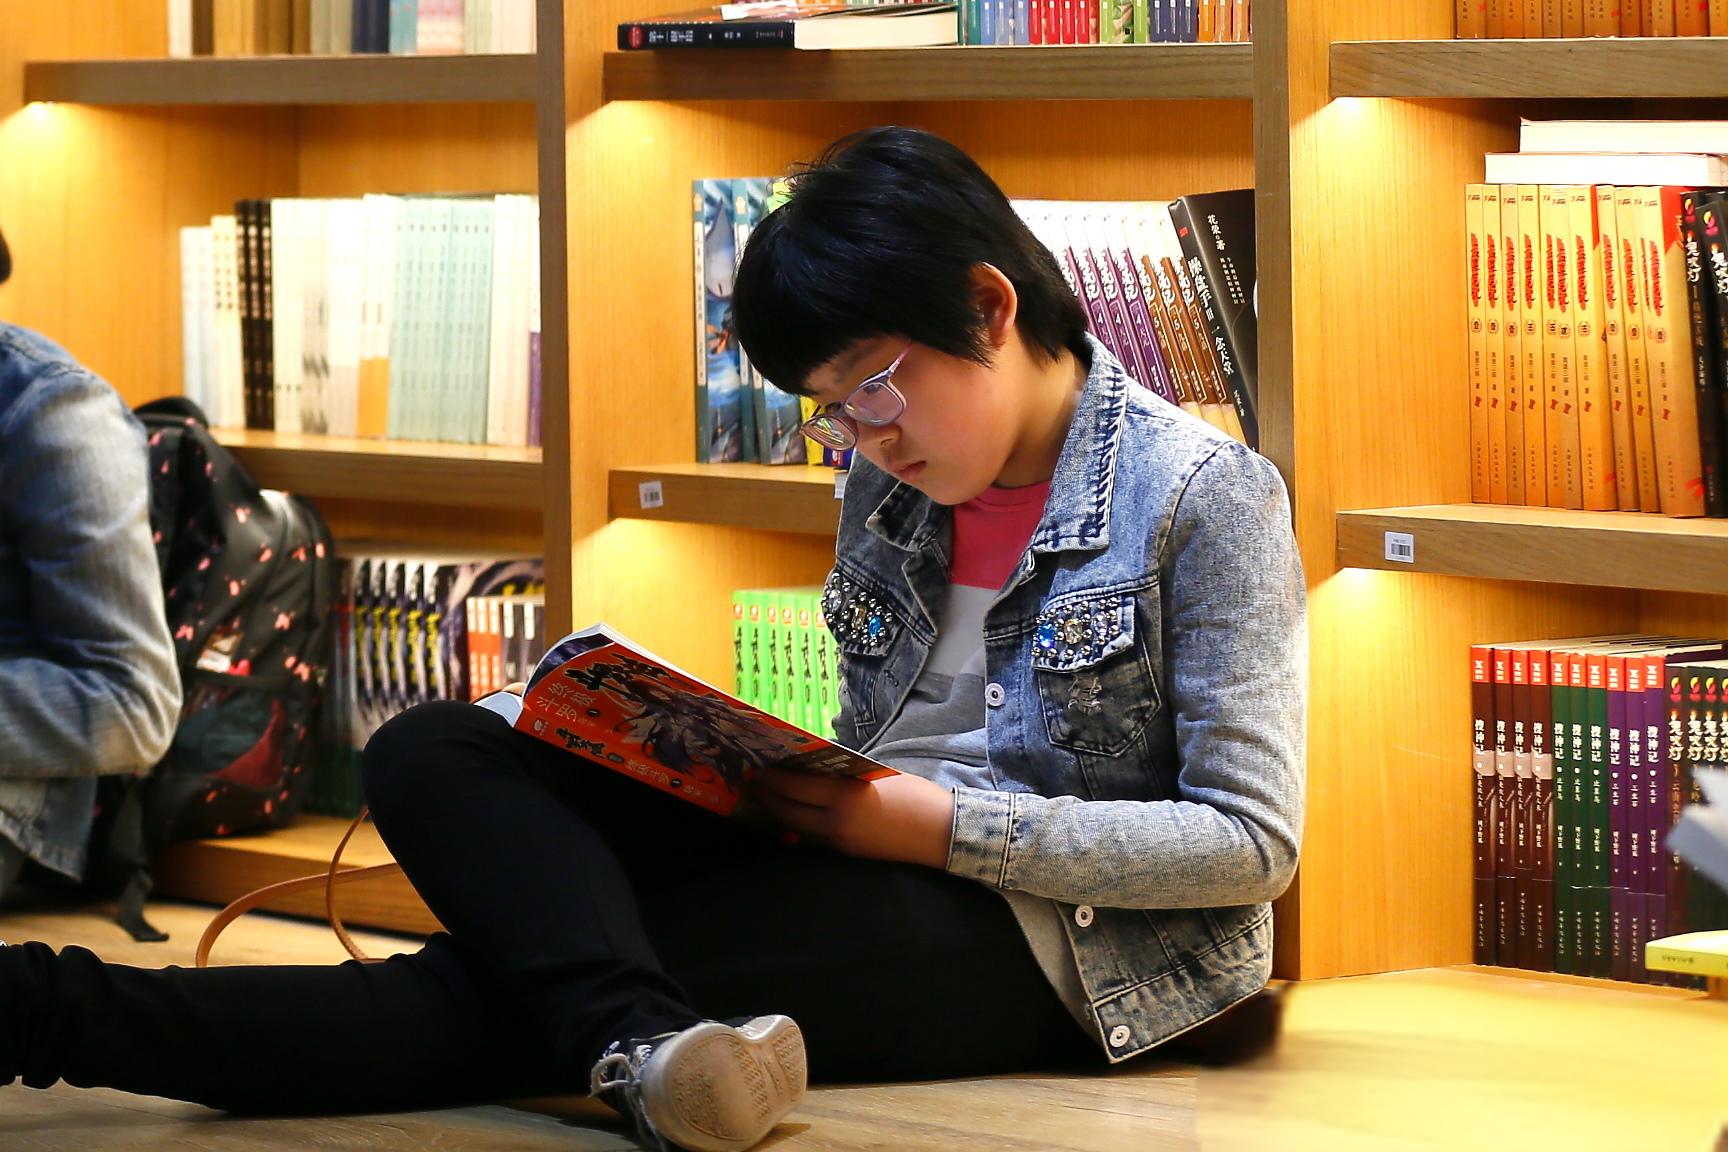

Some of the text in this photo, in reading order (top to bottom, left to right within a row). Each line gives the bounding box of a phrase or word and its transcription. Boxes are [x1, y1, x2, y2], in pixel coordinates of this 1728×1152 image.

[1685, 233, 1701, 283] 鬼吹灯
[1669, 715, 1683, 761] 鬼吹灯
[1688, 715, 1701, 761] 鬼吹灯
[1704, 715, 1718, 761] 鬼吹灯
